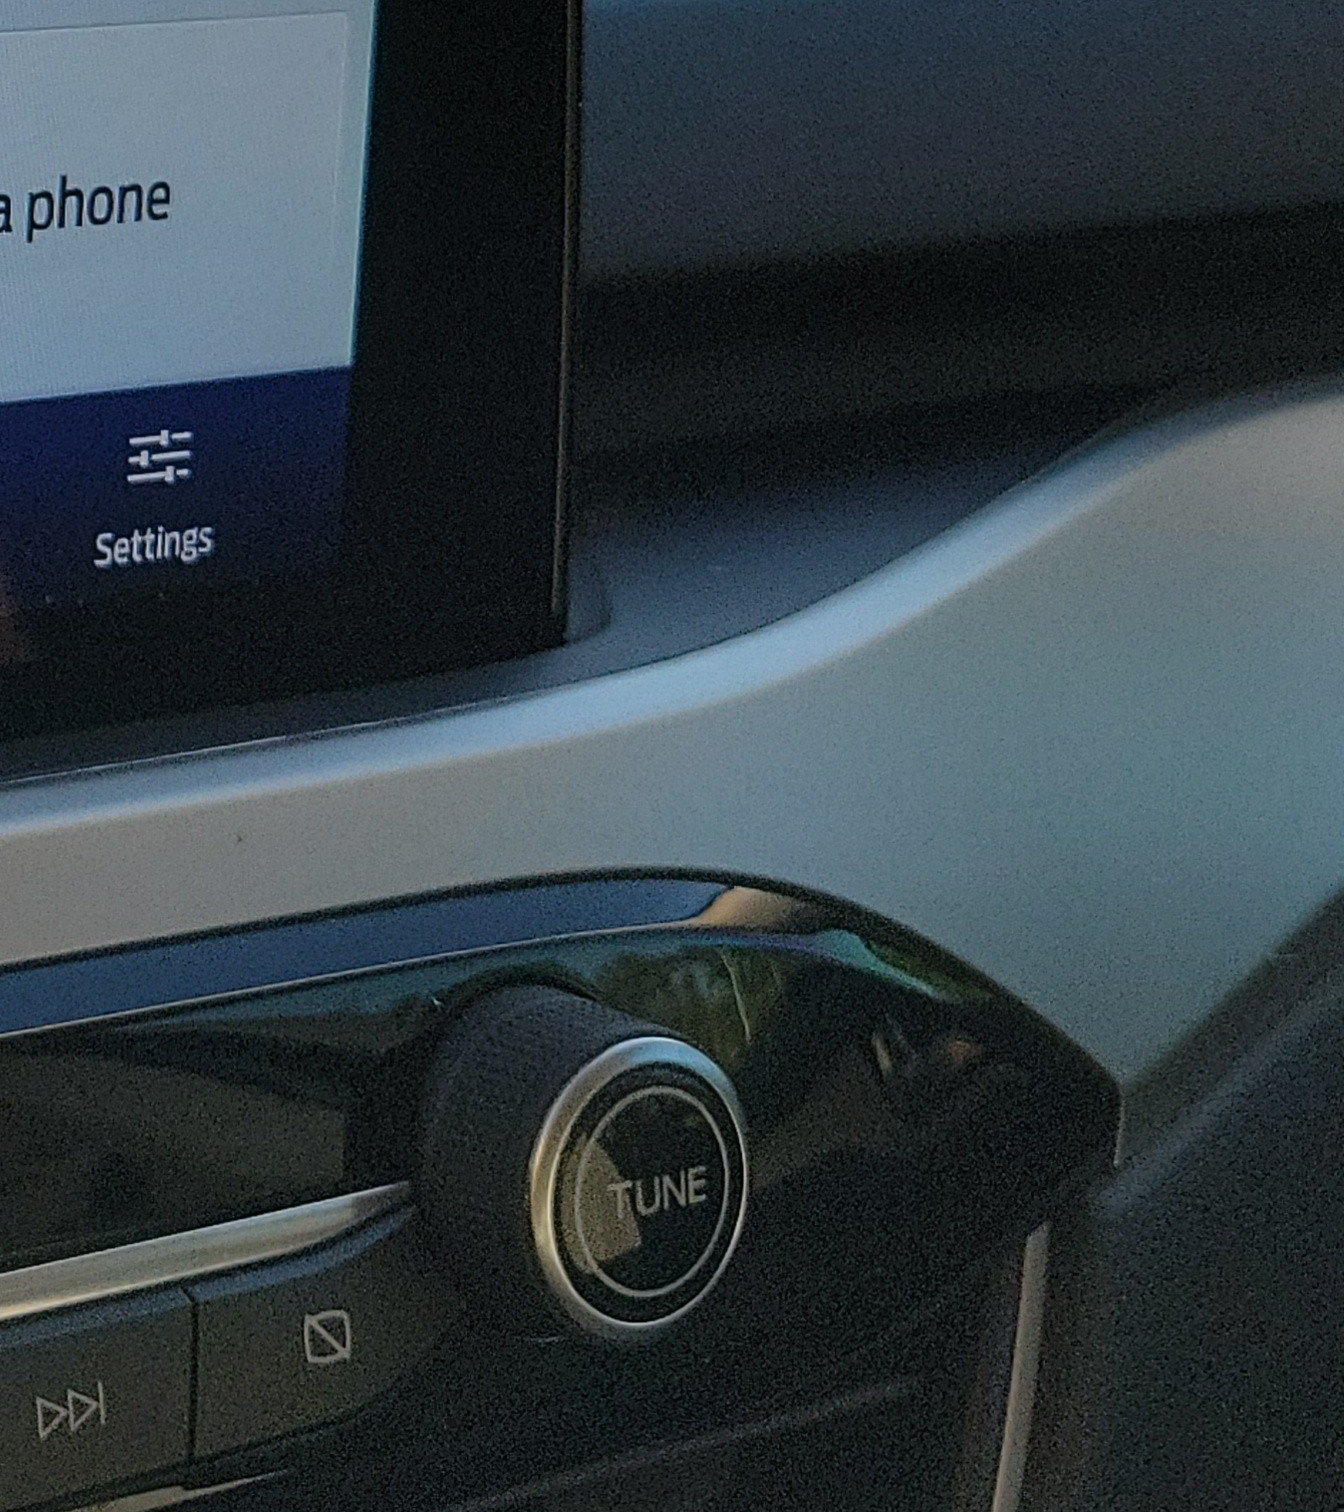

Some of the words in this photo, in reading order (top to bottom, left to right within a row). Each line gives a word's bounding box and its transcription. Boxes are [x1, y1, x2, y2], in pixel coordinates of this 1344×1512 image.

[26, 173, 172, 244] phone
[93, 524, 214, 569] Settings
[606, 1165, 708, 1220] TUNE
